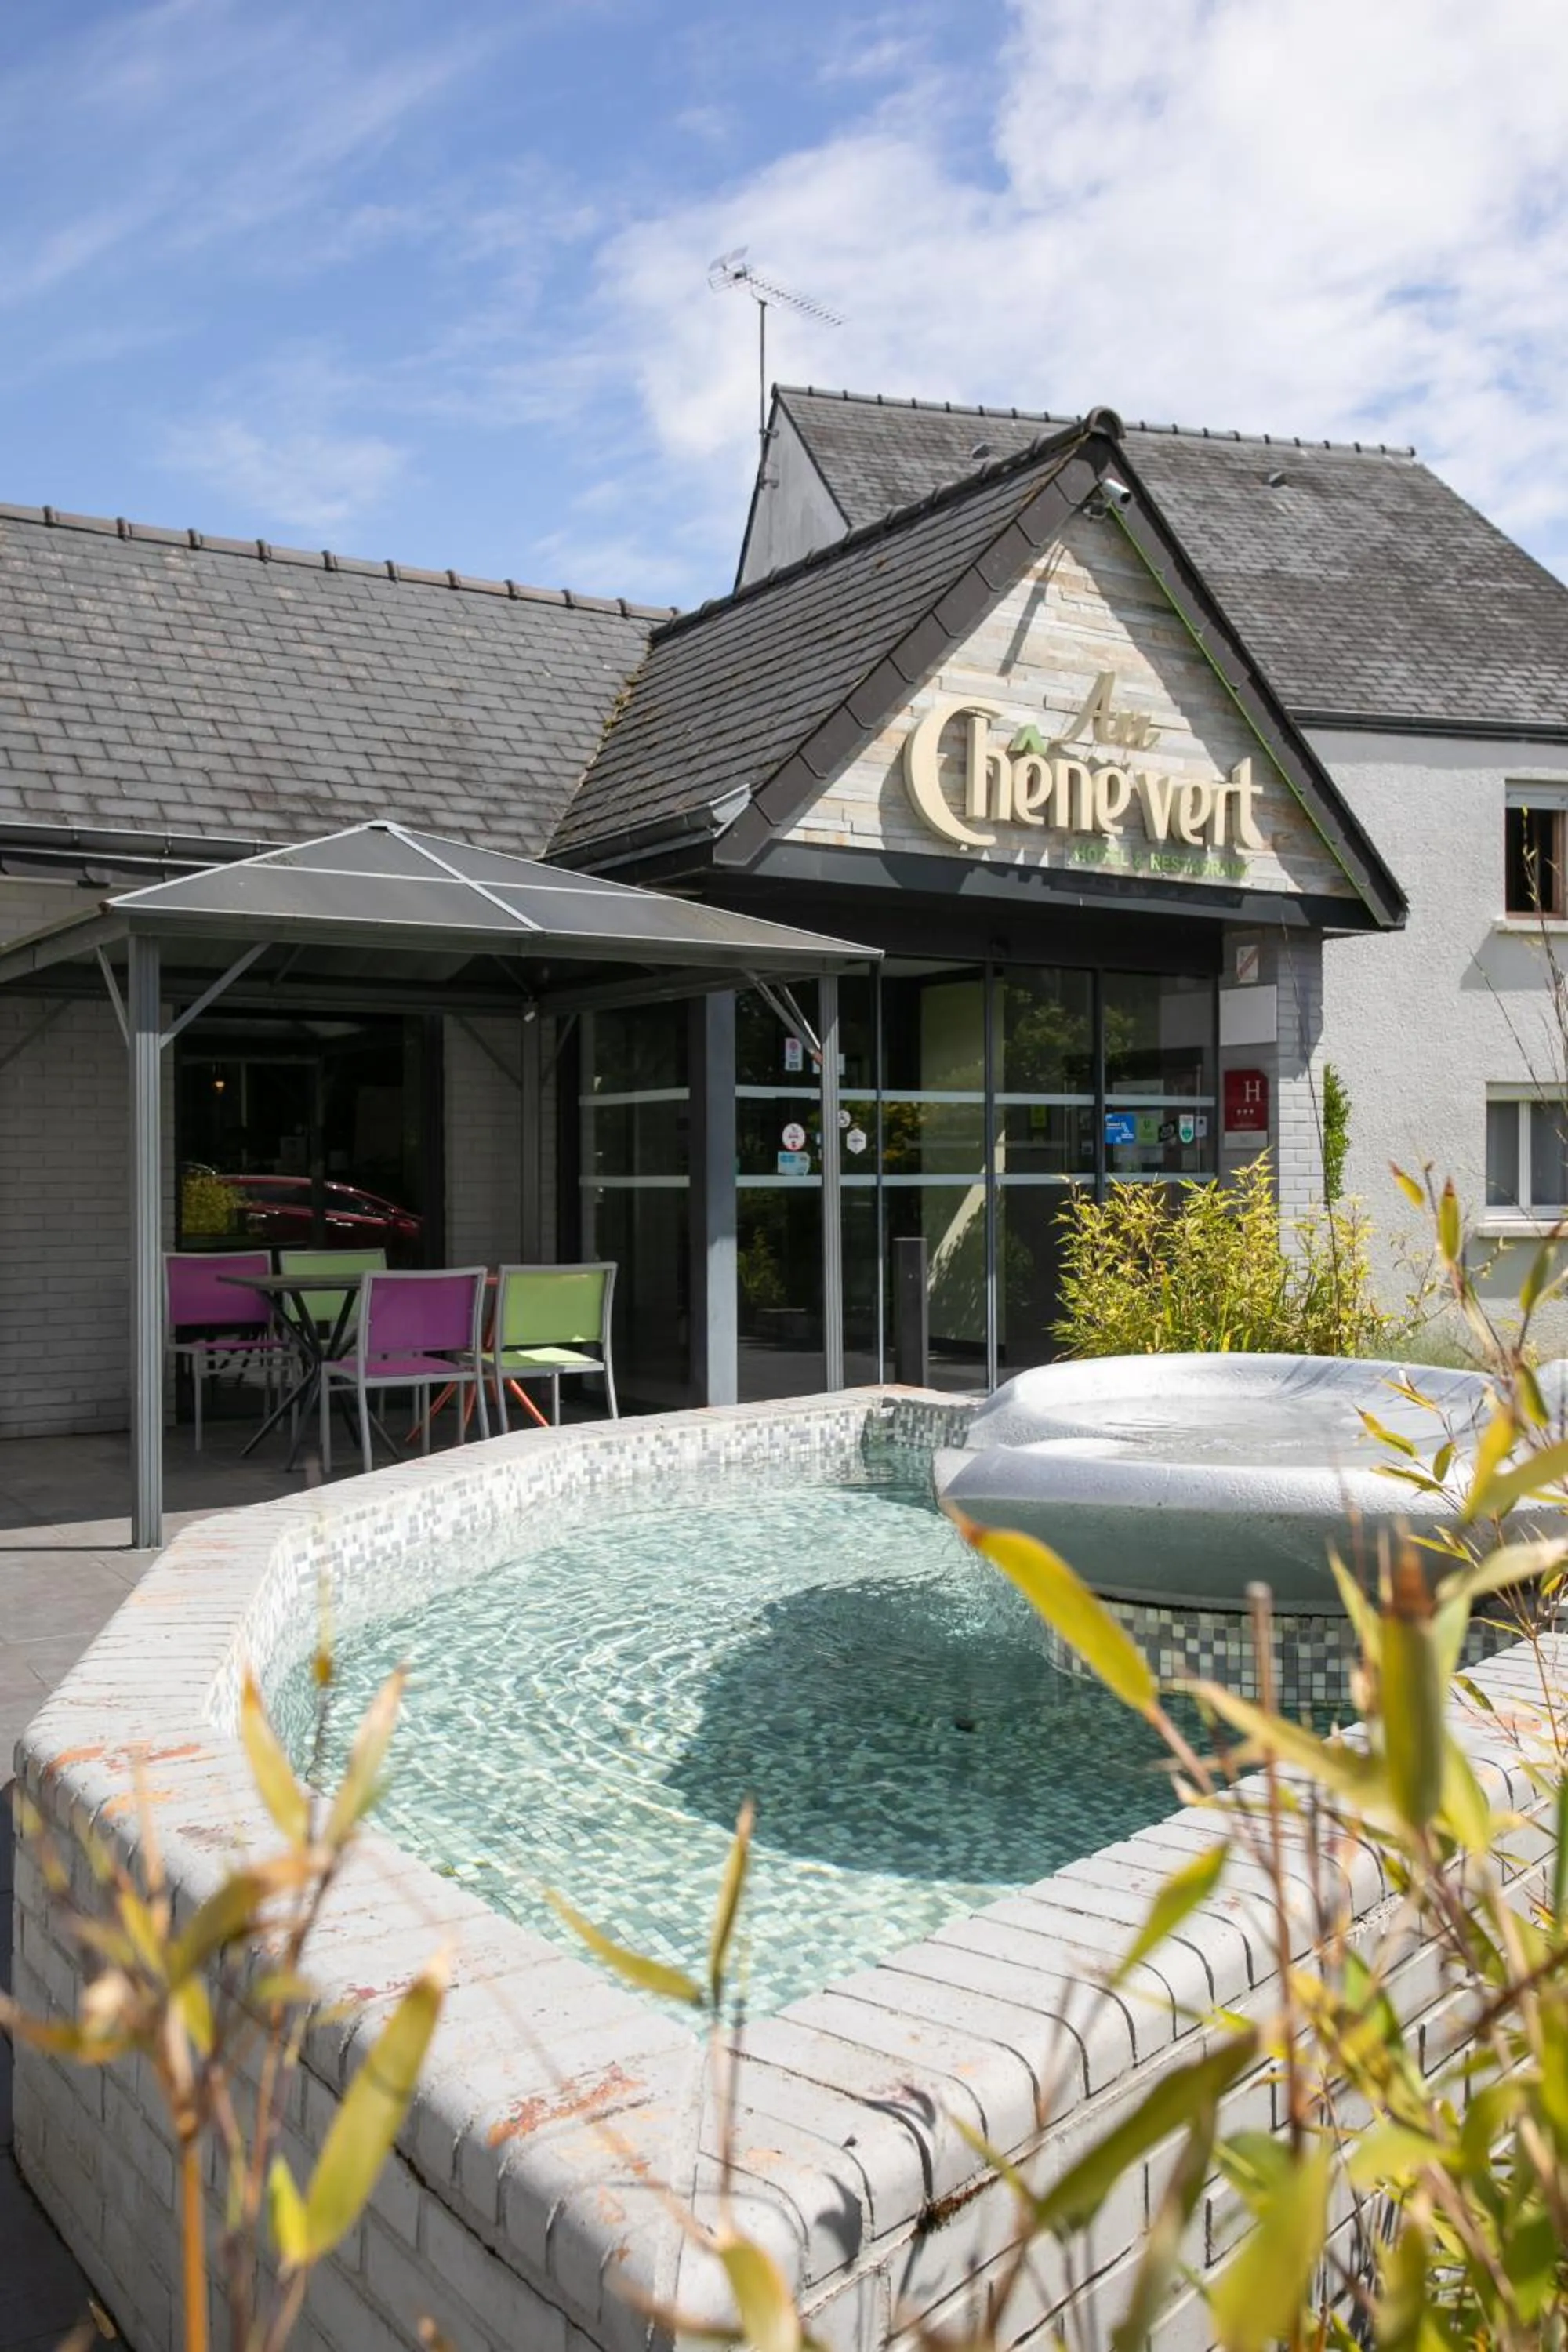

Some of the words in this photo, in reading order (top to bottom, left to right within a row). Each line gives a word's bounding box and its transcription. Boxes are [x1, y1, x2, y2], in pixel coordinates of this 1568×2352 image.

[1051, 669, 1161, 750] Au
[905, 698, 1134, 846] Chêne
[1244, 1080, 1261, 1102] H
